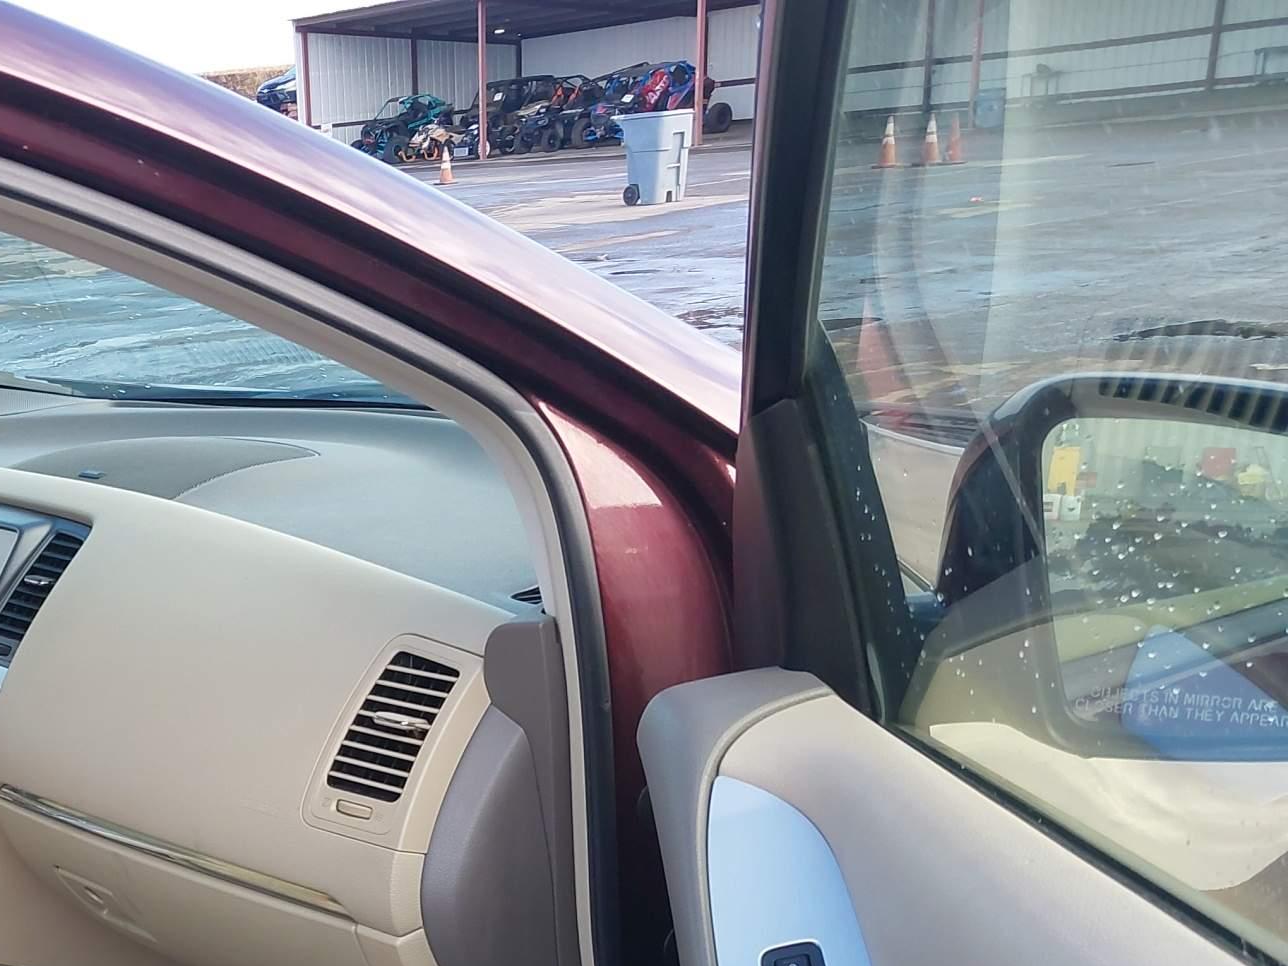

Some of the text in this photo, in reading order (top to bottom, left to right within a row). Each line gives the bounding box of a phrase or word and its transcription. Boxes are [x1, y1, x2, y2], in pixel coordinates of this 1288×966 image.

[1164, 690, 1180, 705] IN
[1183, 692, 1243, 710] MIRROR
[1248, 698, 1278, 713] ARE
[1140, 703, 1178, 719] THAN
[1184, 707, 1225, 722] THEY
